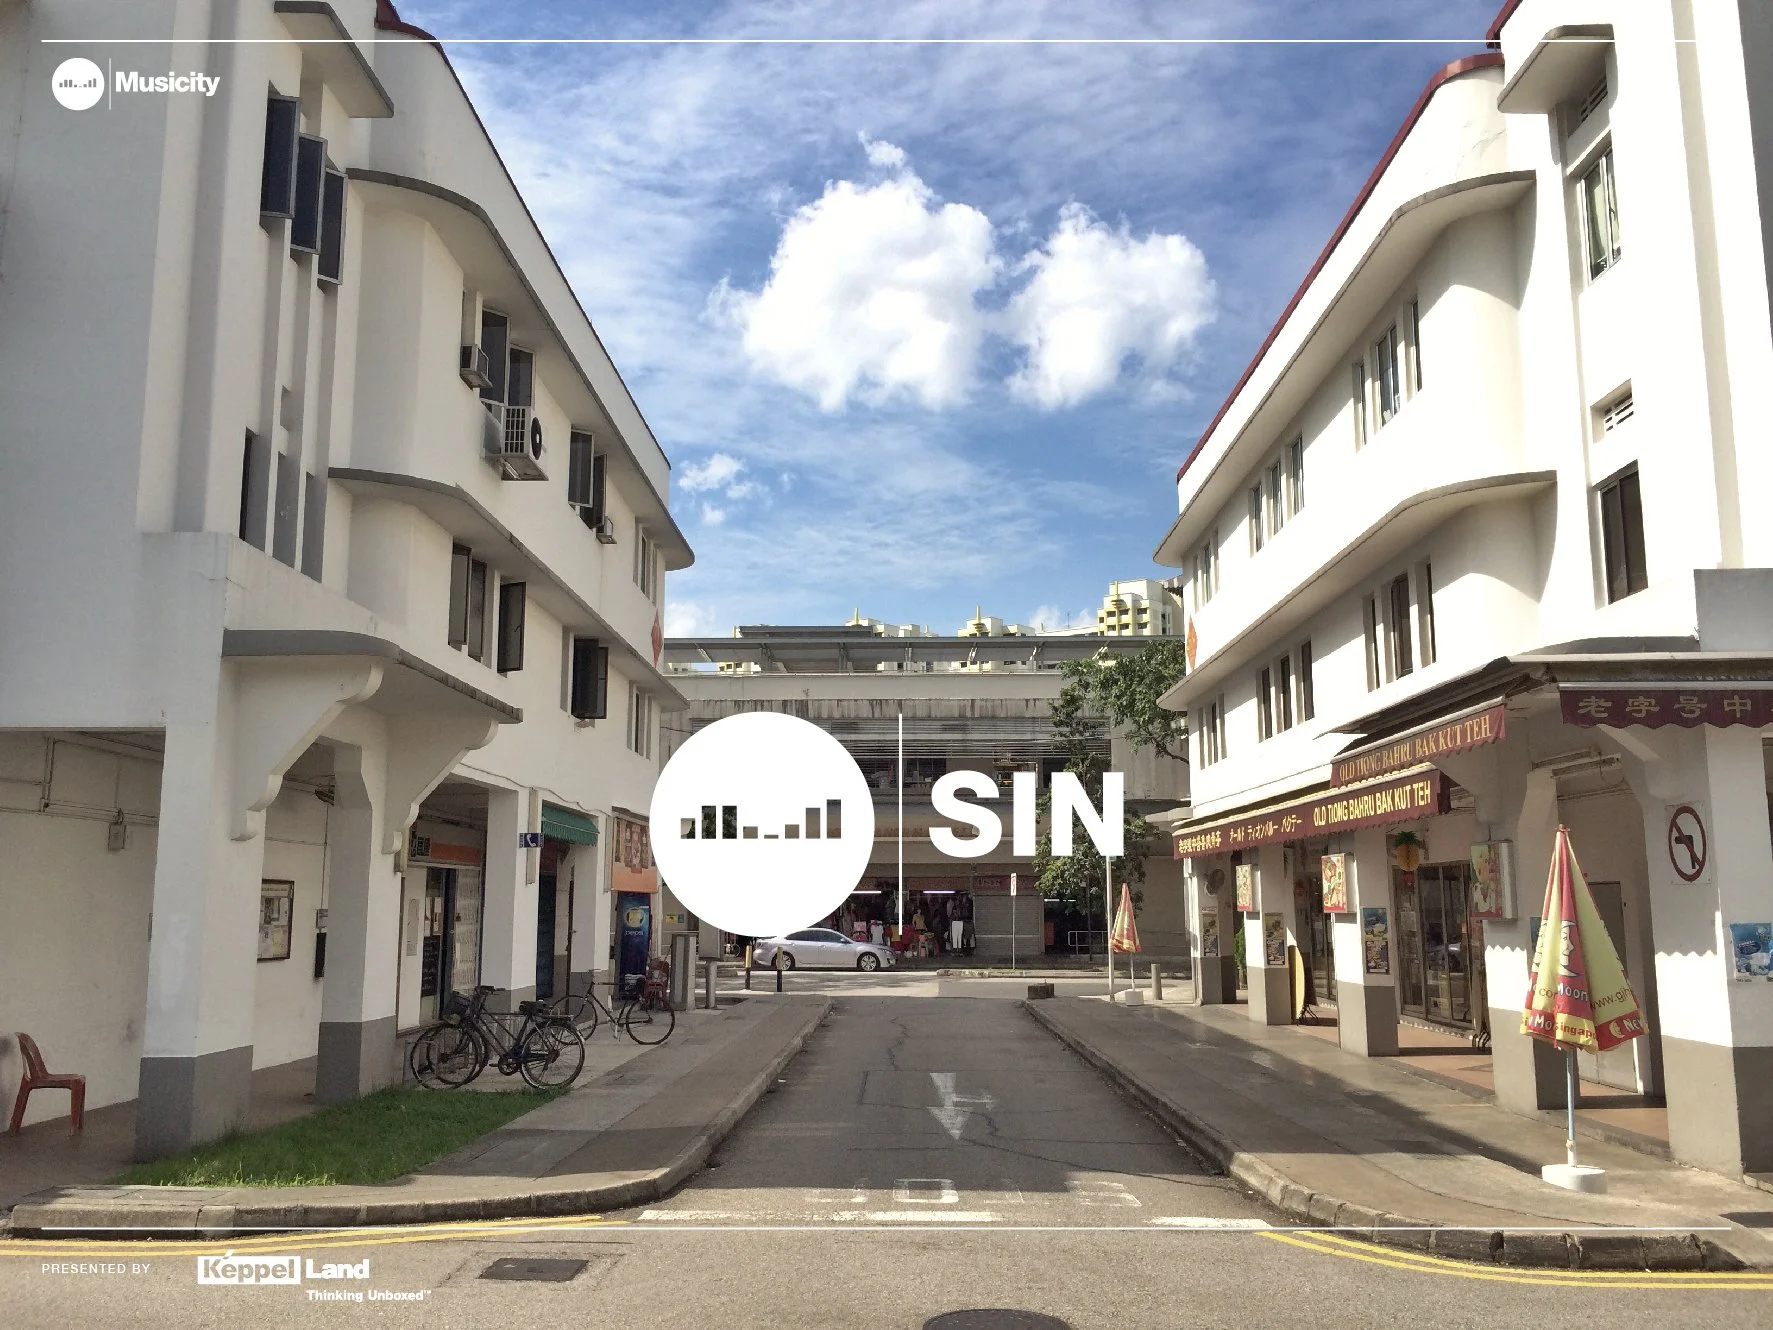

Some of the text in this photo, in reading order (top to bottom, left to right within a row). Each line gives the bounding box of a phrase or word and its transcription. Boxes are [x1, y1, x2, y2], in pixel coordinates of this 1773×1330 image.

[1577, 695, 1773, 718] 老字号中
[1339, 715, 1492, 782] OLD TIONG BAHRU BAK KUT TEH
[1313, 780, 1431, 827] OLD TIONG BAHRU BAK KUT TEH
